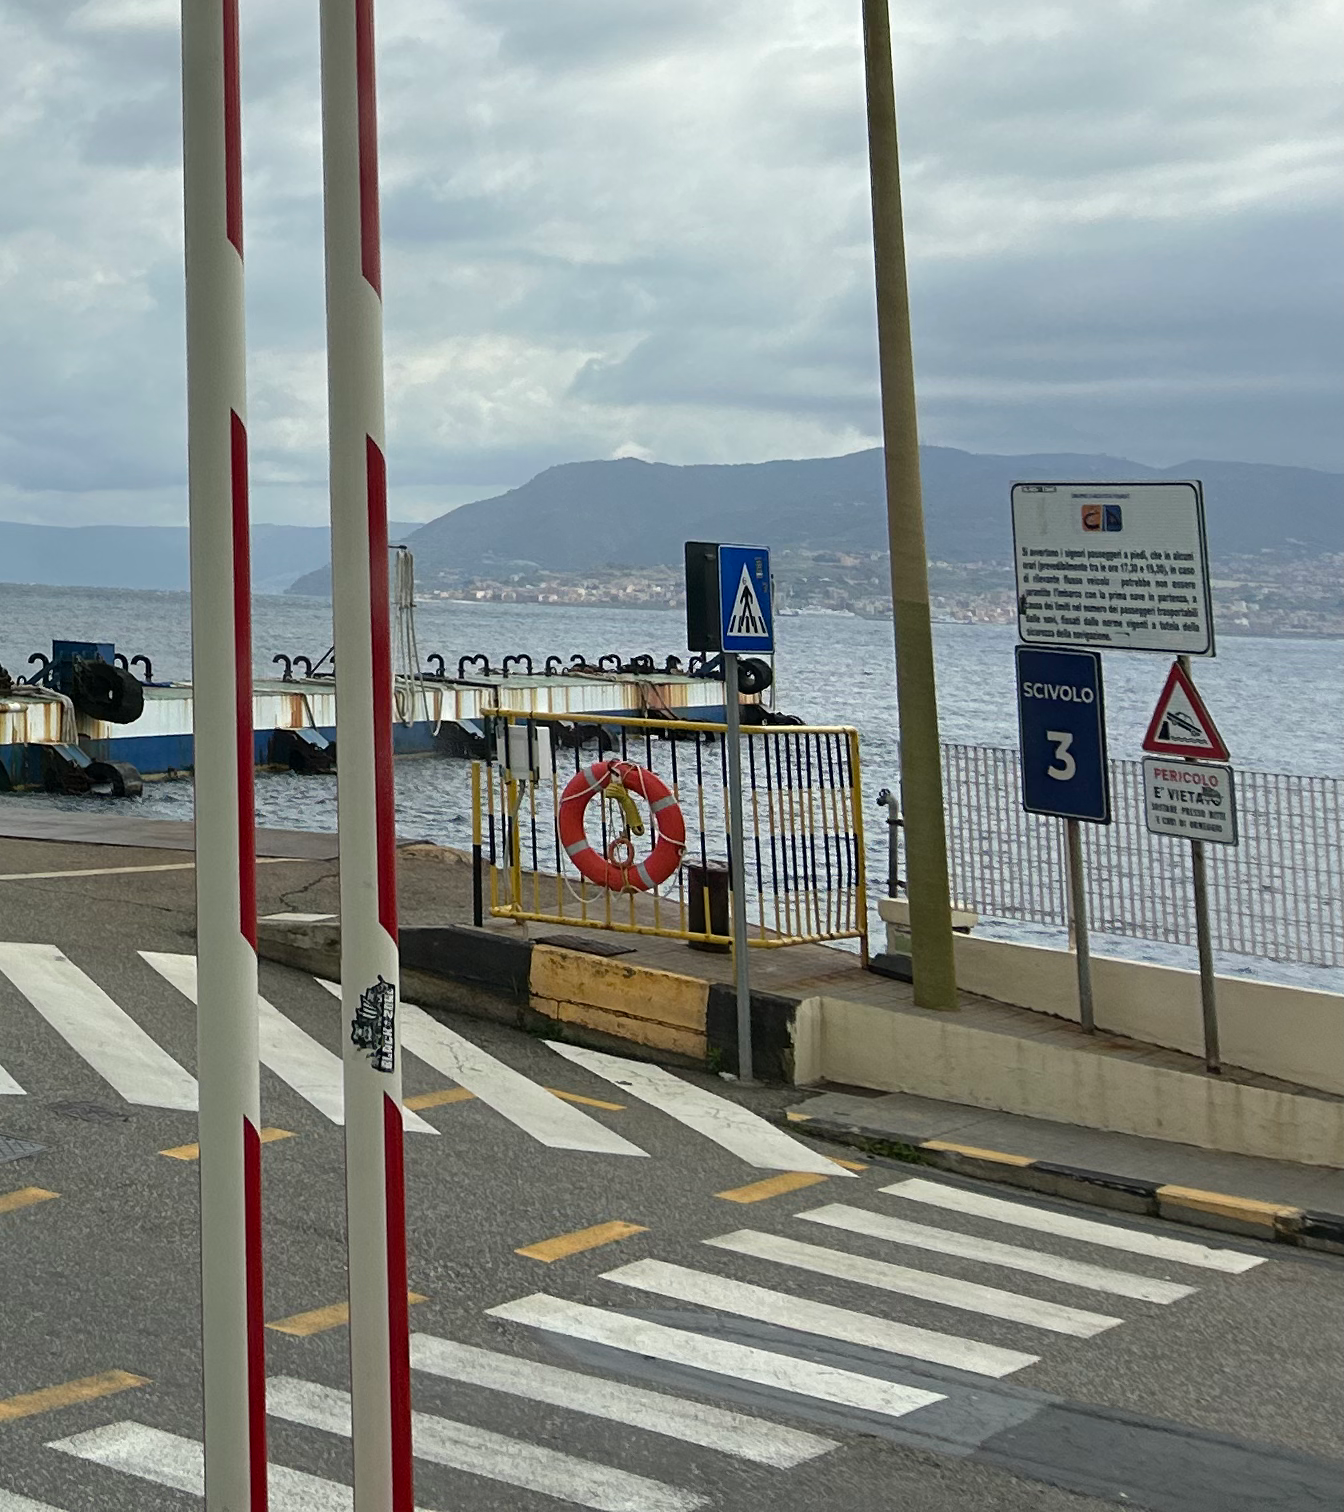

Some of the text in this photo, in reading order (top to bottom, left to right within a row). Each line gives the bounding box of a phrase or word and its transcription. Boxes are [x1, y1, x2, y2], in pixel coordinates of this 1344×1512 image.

[1023, 682, 1094, 703] SCIVOLO
[1046, 730, 1077, 781] 3
[1153, 768, 1219, 787] PERICOLO
